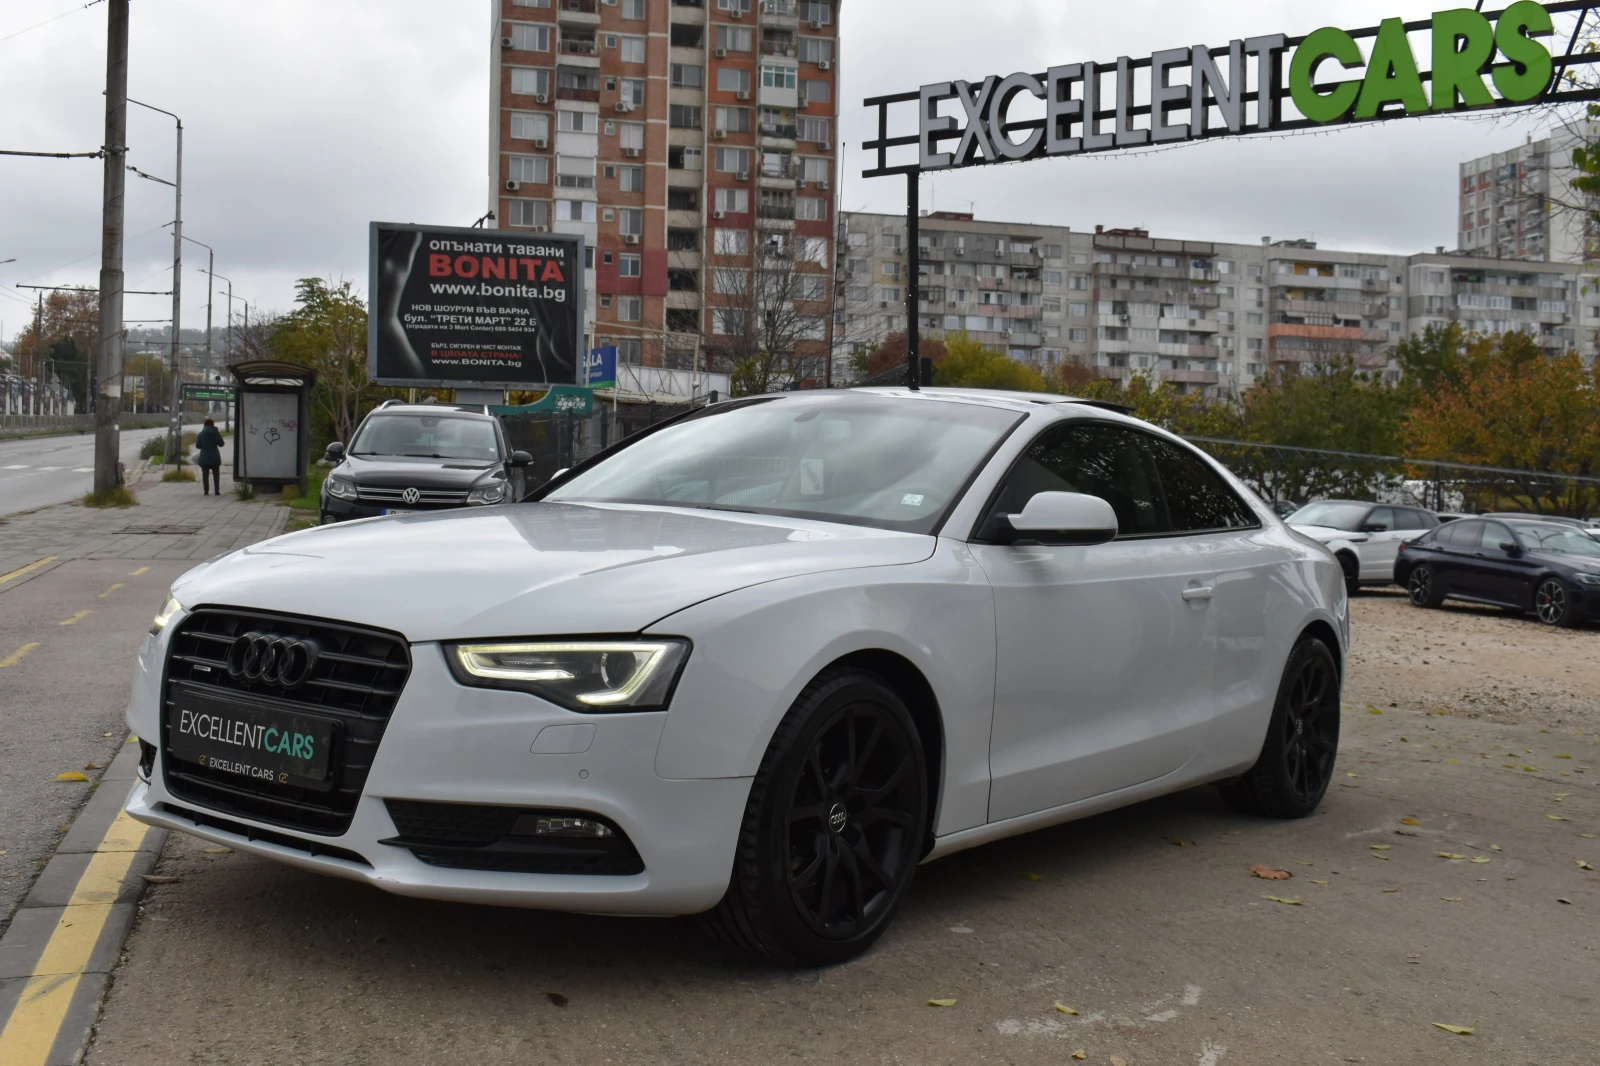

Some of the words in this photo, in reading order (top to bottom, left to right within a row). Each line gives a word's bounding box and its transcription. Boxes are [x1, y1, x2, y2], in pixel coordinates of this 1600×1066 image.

[429, 240, 503, 254] опънати
[507, 244, 565, 257] тавани
[430, 282, 566, 302] www.bonita.bg
[434, 305, 474, 313] ШОУРУМ
[476, 306, 497, 314] ВЪВ
[499, 307, 530, 315] ВАРНА
[404, 313, 427, 323] бул.
[514, 317, 527, 326] 22
[529, 318, 537, 326] Б
[432, 358, 522, 367] www.BONITA.bg
[209, 757, 251, 776] EXCELLENT
[251, 766, 274, 781] CARS
